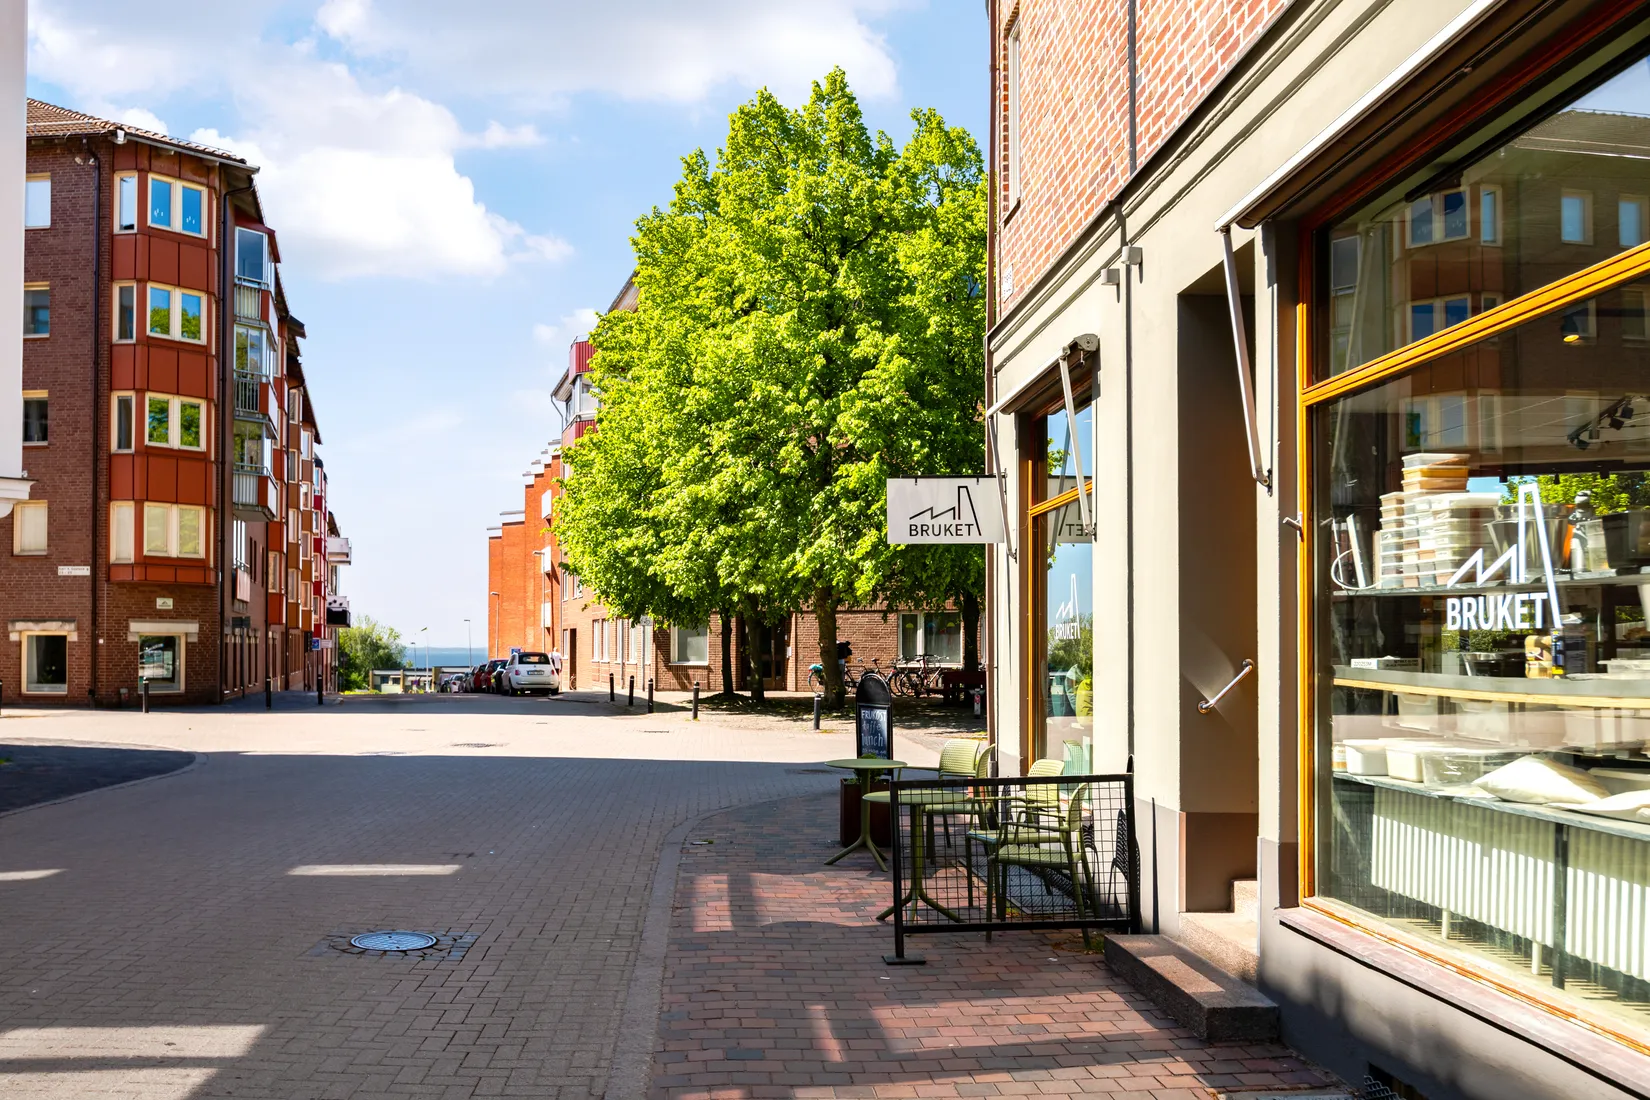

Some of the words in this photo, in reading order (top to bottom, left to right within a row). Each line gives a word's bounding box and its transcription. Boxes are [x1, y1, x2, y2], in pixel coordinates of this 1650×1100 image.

[909, 523, 974, 537] BRUKET
[1446, 592, 1548, 631] BRUKET
[1055, 622, 1078, 640] BRUKET
[861, 709, 887, 722] FRUKOST
[861, 733, 884, 747] lunch
